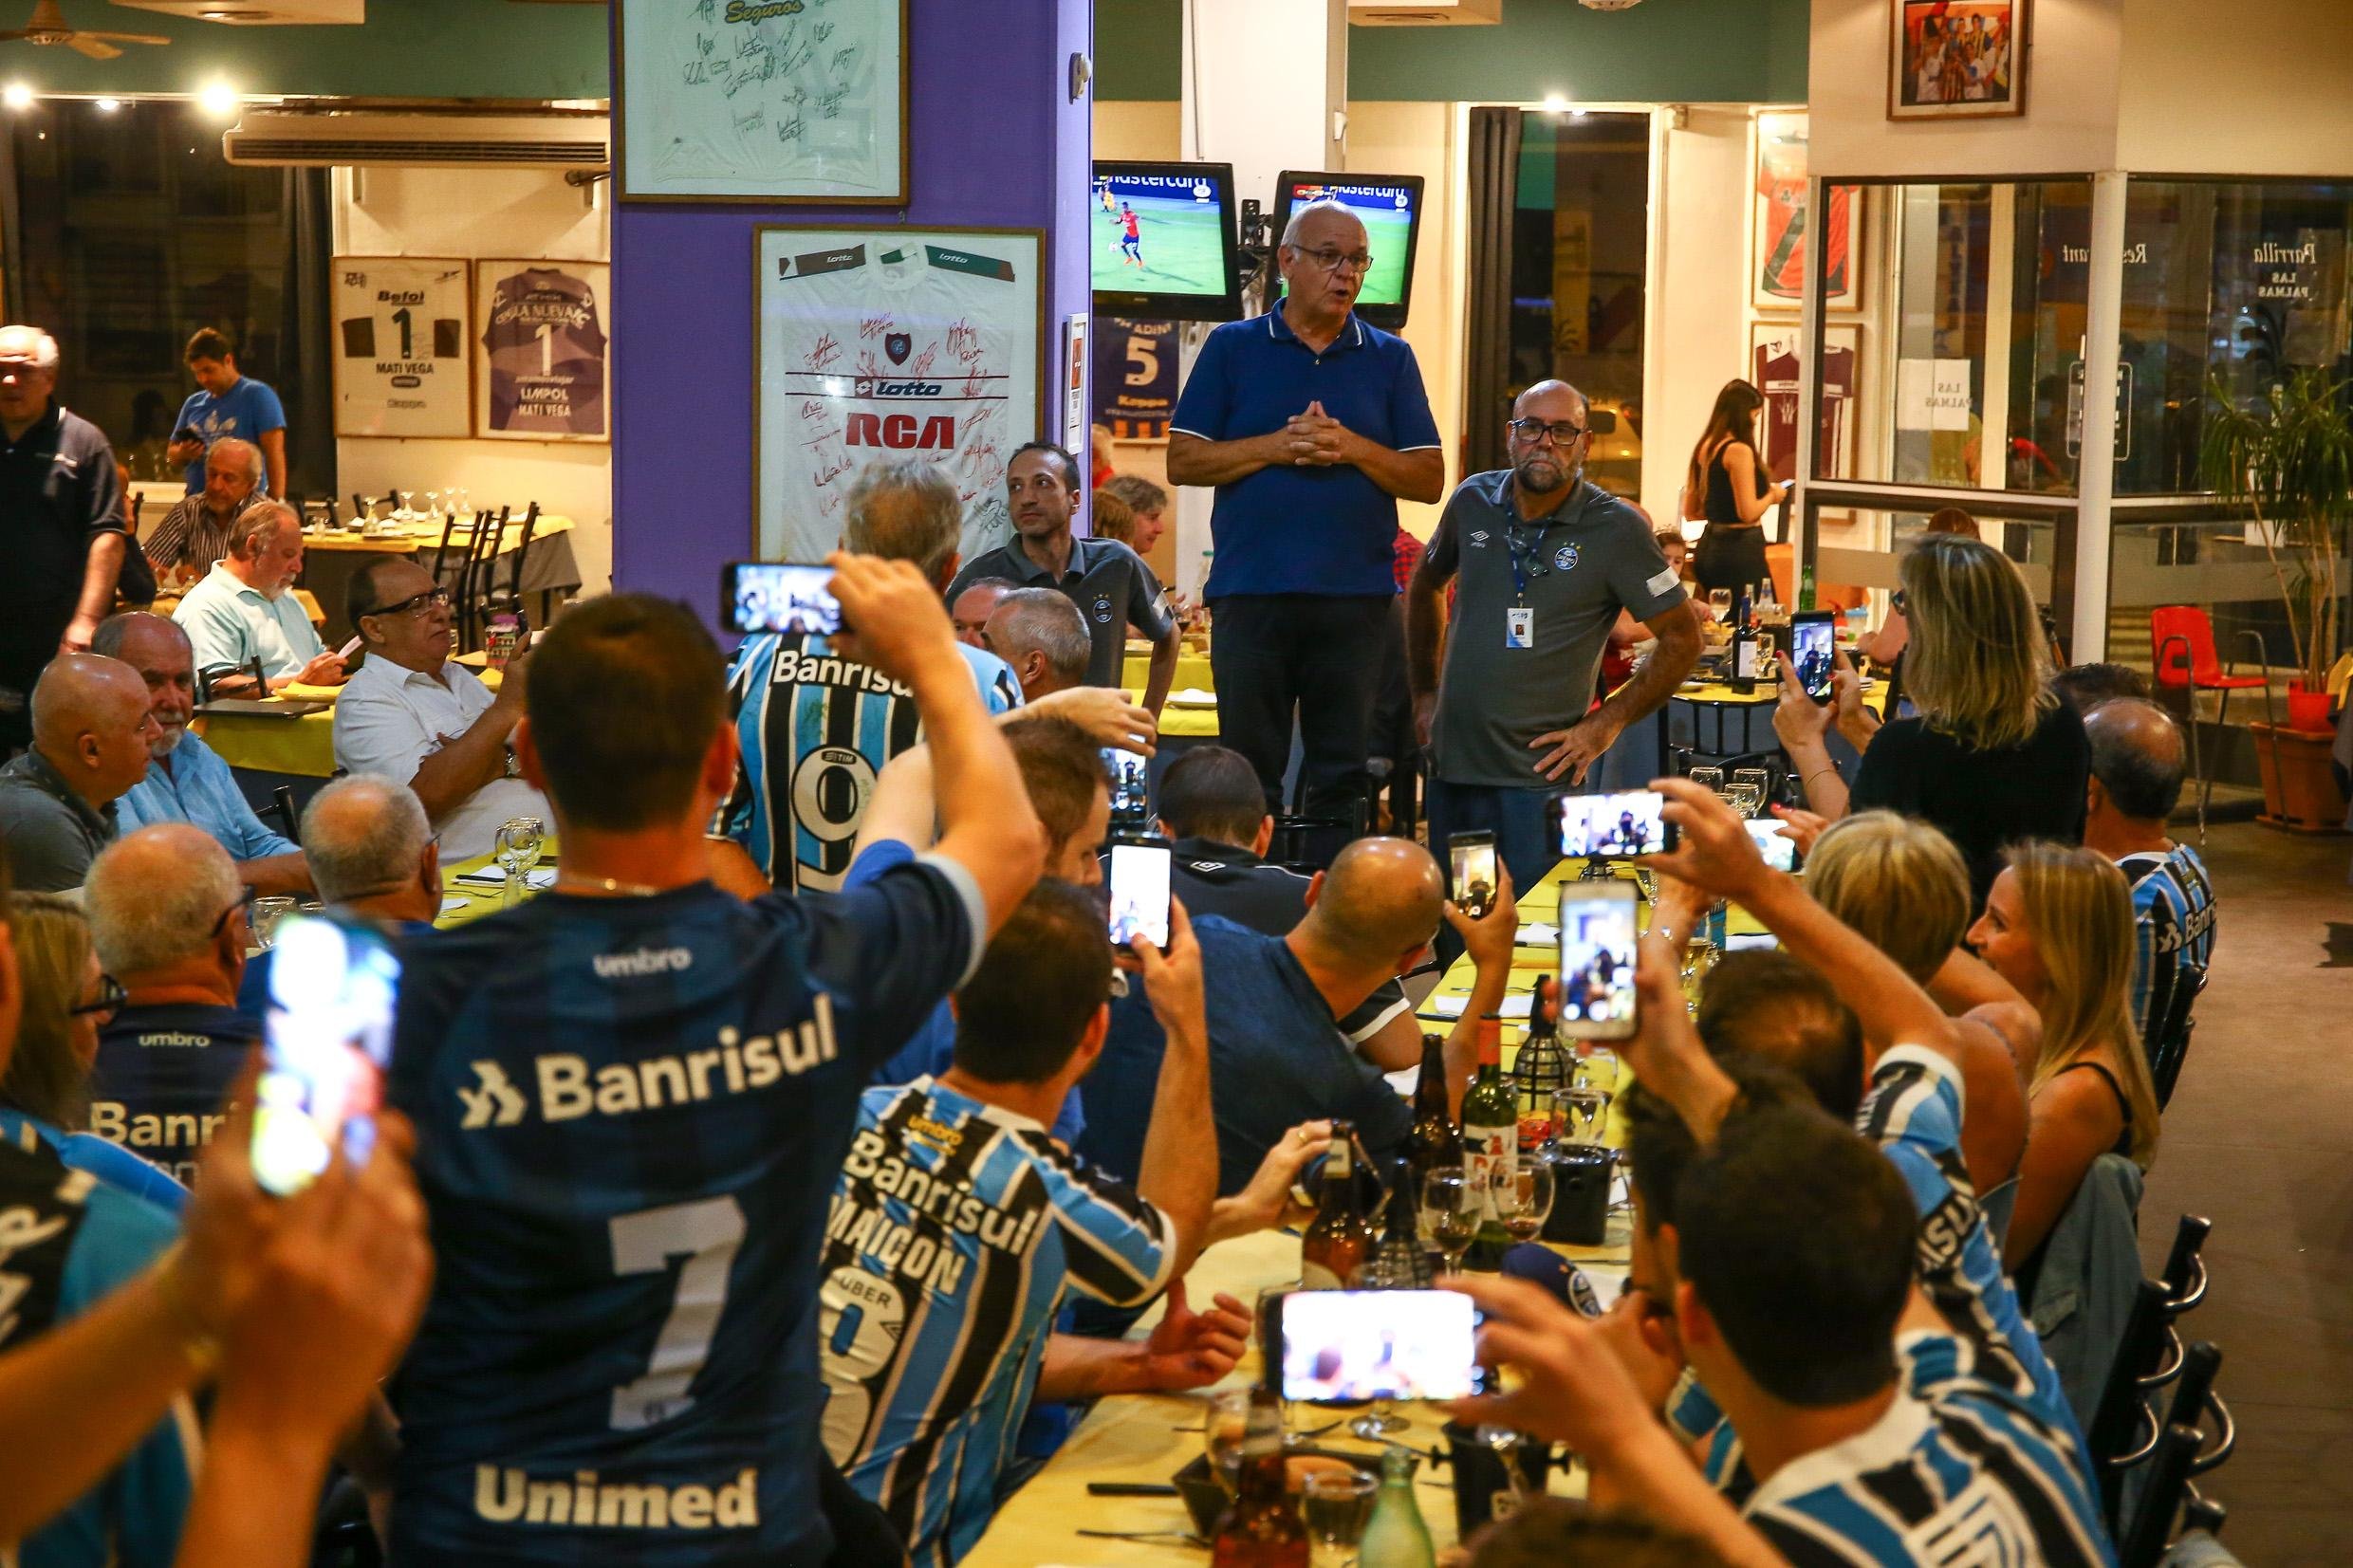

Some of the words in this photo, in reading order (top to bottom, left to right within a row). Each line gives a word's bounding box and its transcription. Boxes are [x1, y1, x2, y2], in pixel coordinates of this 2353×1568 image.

[725, 1, 805, 26] Seguros
[392, 307, 412, 360] 1
[536, 323, 552, 377] 1
[377, 363, 402, 374] MATI
[405, 363, 434, 374] VEGA
[1124, 336, 1159, 386] 5
[519, 403, 544, 415] MATI
[876, 381, 942, 397] lotto
[845, 412, 955, 450] RCA
[791, 745, 879, 894] 9
[592, 947, 694, 978] umbro
[138, 1031, 211, 1047] umbro
[534, 991, 838, 1123] Banrisul
[843, 1129, 1041, 1256] Banrisul
[824, 1193, 967, 1297] MAICON
[607, 1193, 749, 1430] 7
[475, 1463, 760, 1530] Unimed
